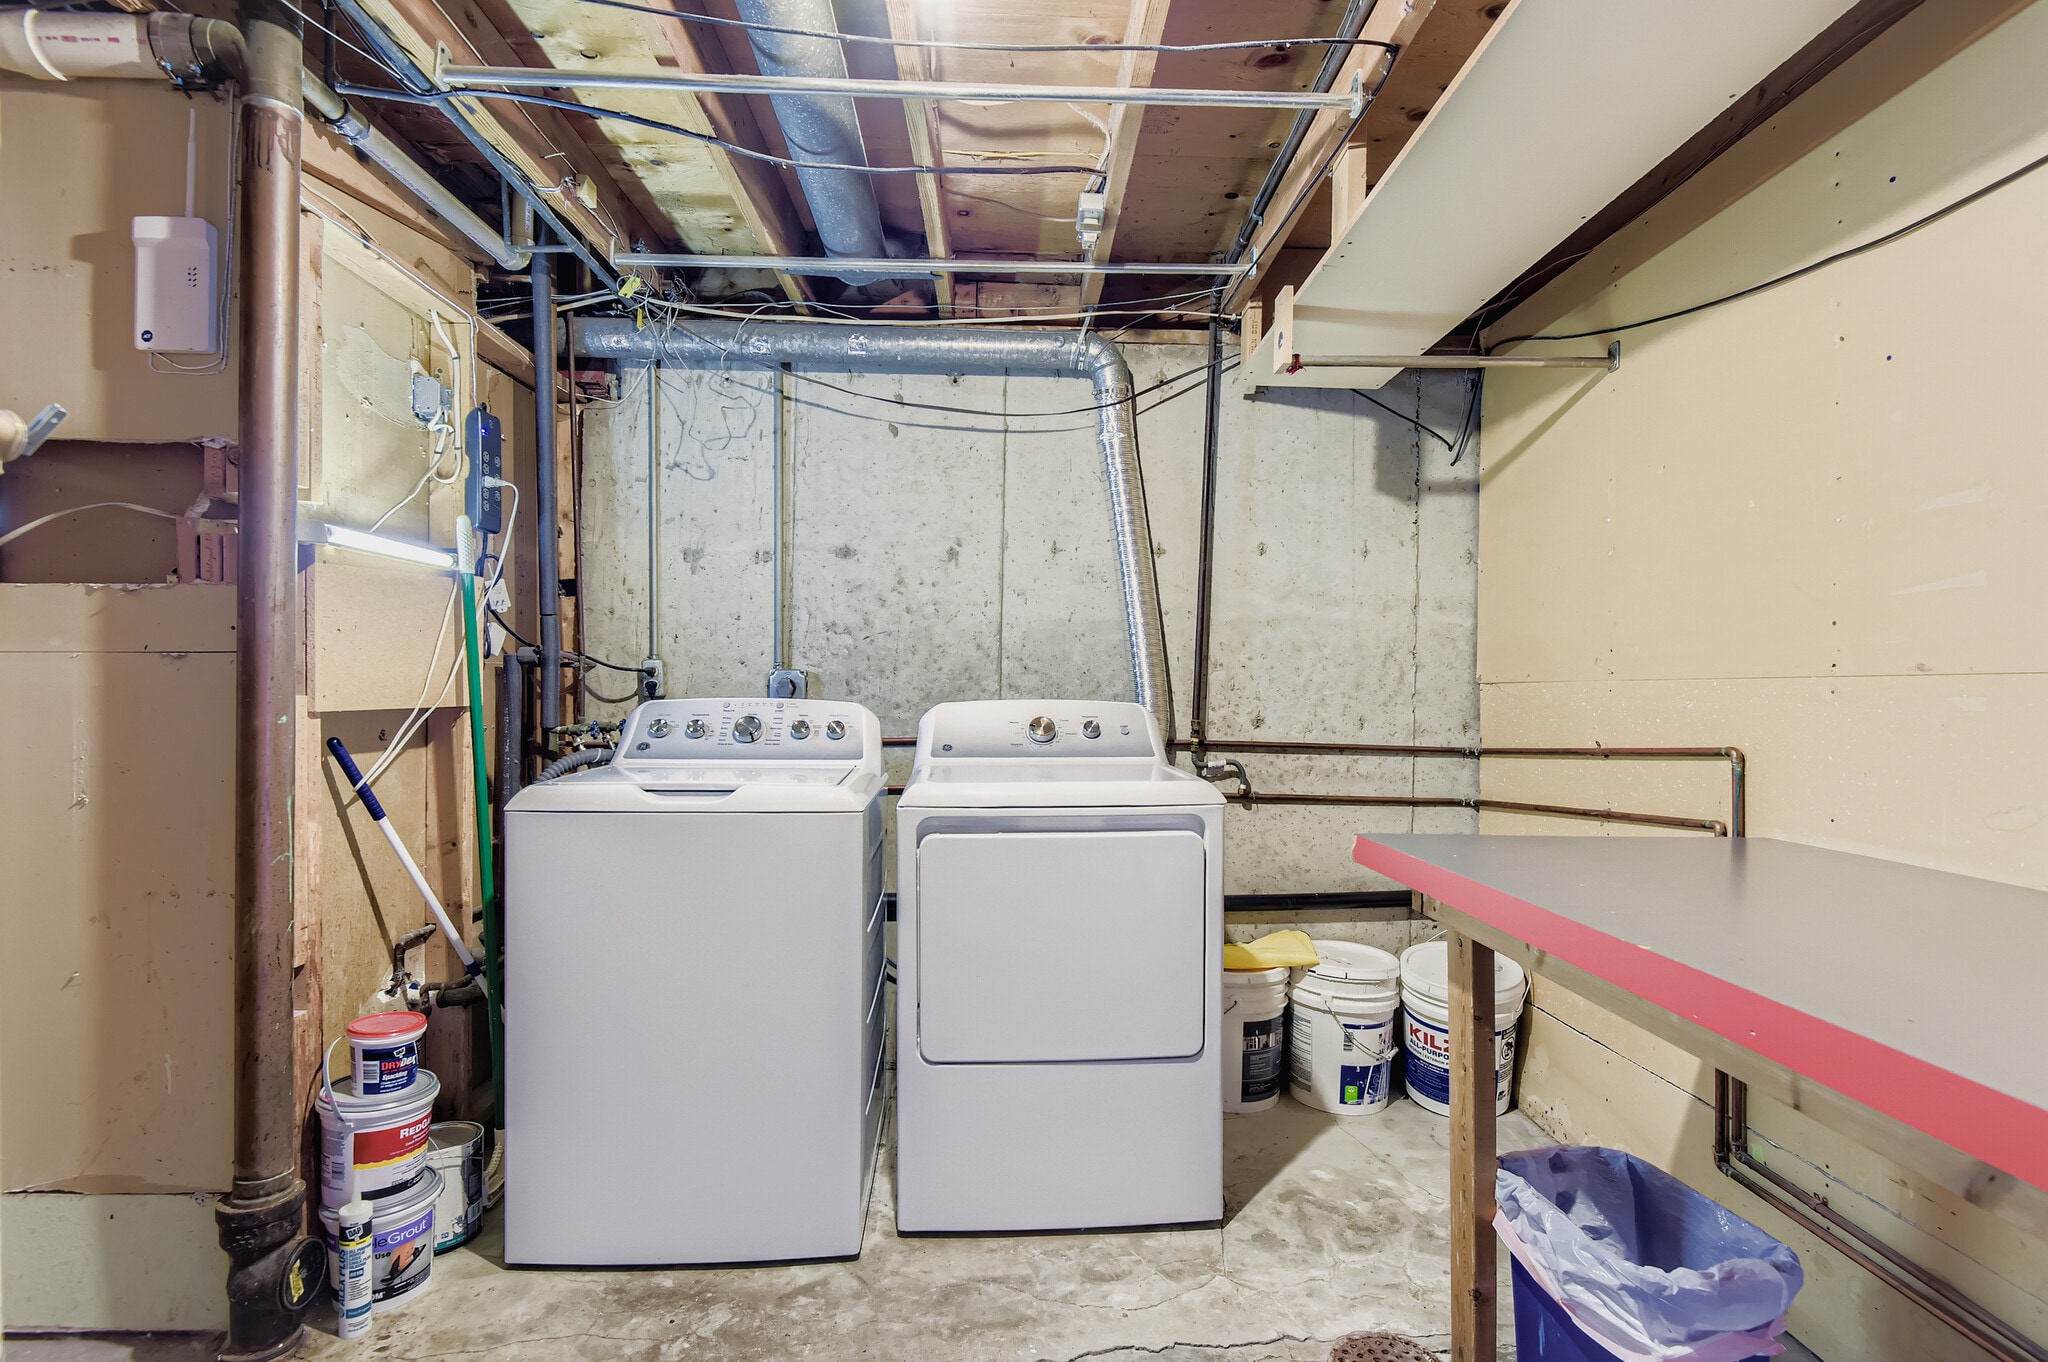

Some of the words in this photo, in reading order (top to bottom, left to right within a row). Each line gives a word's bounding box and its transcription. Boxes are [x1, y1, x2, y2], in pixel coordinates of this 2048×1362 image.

[348, 1226, 362, 1237] DAP
[373, 1219, 426, 1249] leGrout
[375, 1252, 391, 1260] Use
